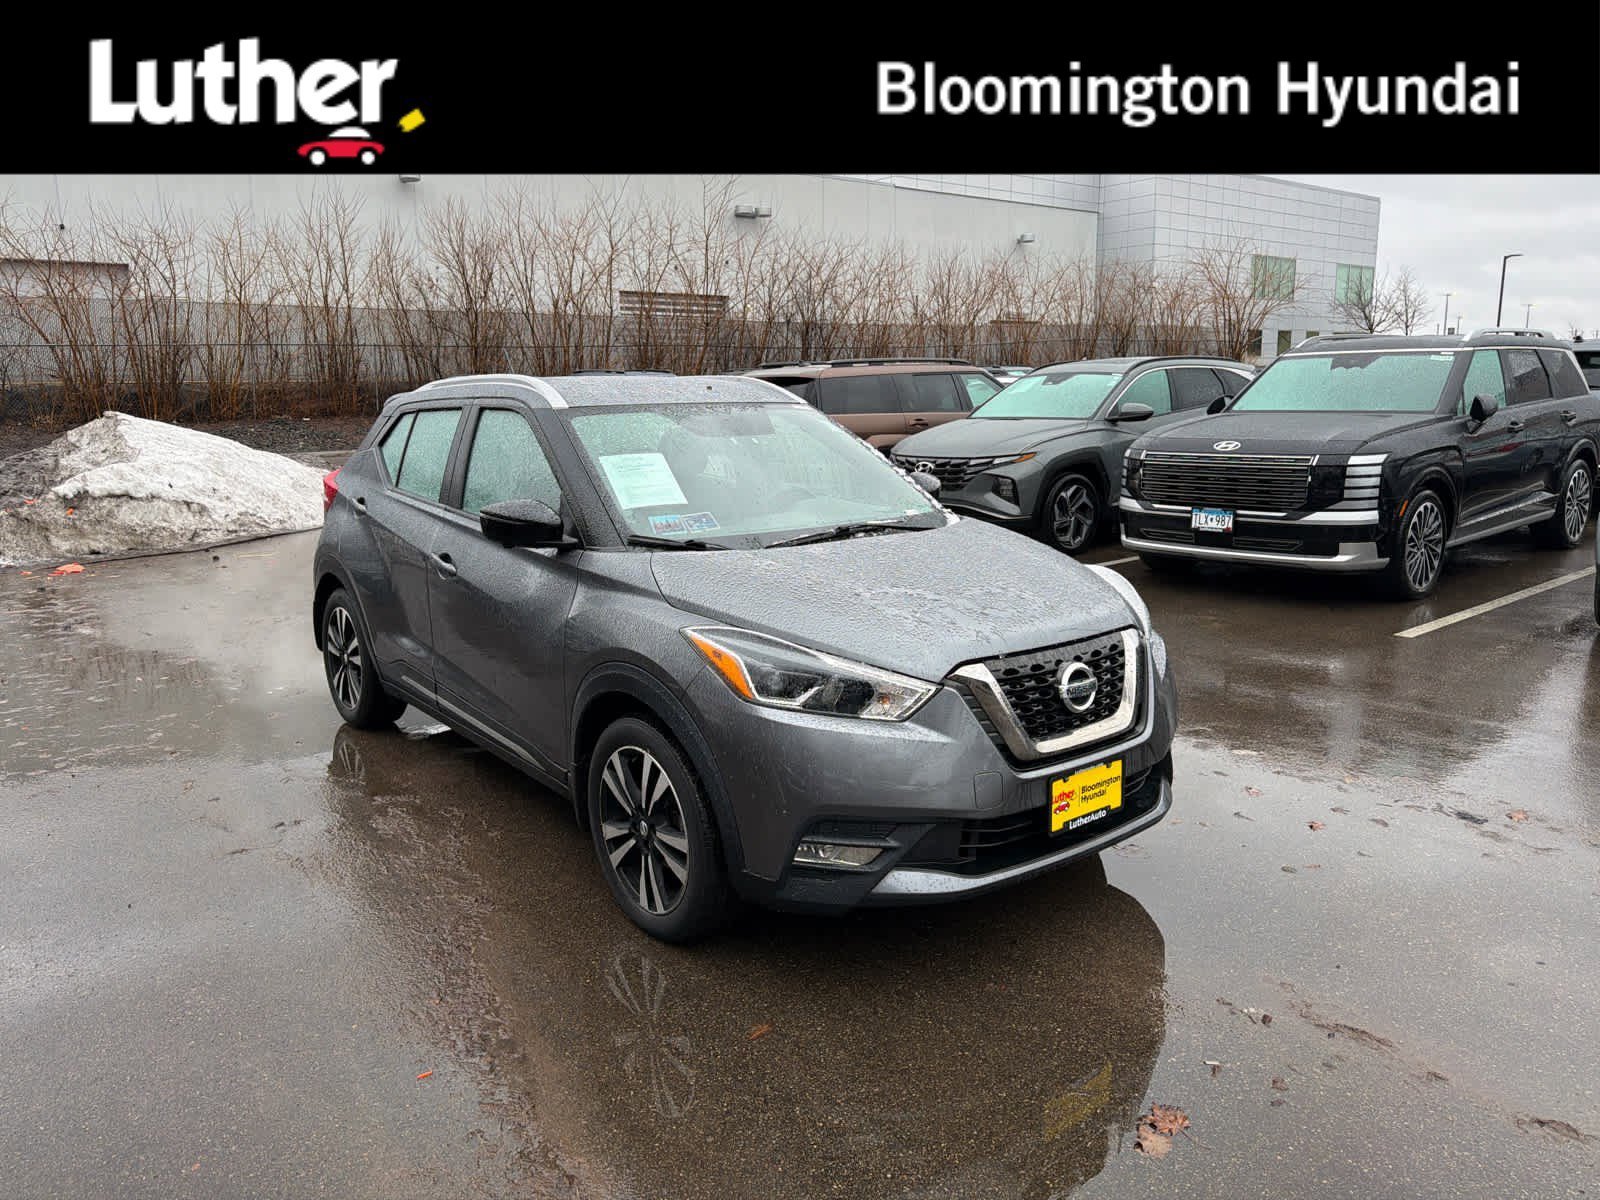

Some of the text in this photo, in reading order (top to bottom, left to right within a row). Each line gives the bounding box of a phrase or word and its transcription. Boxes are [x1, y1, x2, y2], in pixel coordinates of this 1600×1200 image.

[1081, 775, 1121, 794] Bloomington
[1052, 789, 1075, 804] uther
[1081, 788, 1107, 804] Hyundai
[1069, 809, 1107, 829] LutherAuto
